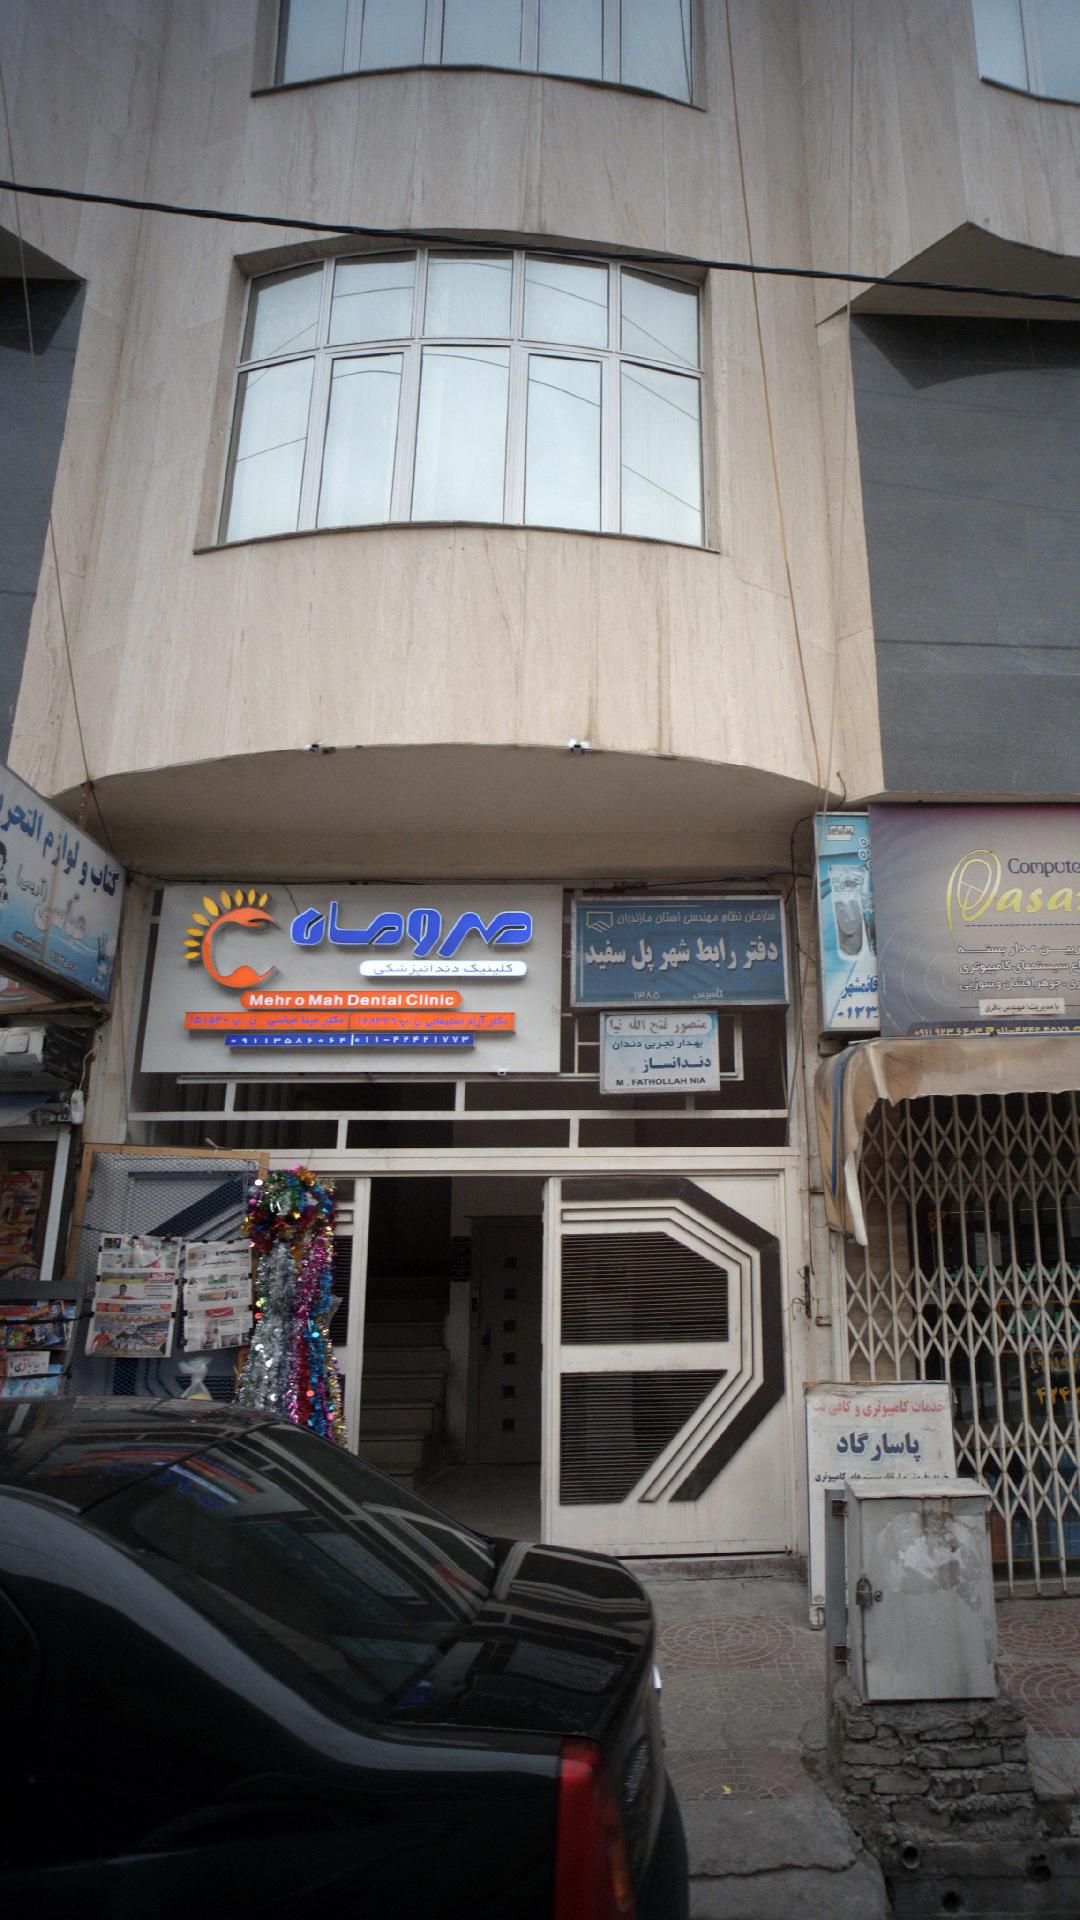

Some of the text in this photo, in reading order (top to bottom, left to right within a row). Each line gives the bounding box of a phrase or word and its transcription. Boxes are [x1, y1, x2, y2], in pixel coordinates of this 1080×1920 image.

[42, 830, 80, 876] لوازم
[79, 861, 88, 886] و
[1007, 857, 1080, 877] Compute
[91, 864, 120, 896] کتاب
[617, 910, 776, 925] سازمان نظام مهندسی استان مازندران
[585, 935, 779, 972] دفتر رابط شهر پل سفید
[463, 963, 513, 976] کلینیک
[250, 993, 455, 1006] Mehr o Mah Dental Clinic
[612, 1040, 642, 1050] دندان
[642, 1056, 712, 1073] دندانساز
[631, 1077, 687, 1086] FATHOLLAH
[689, 1076, 706, 1085] NIA
